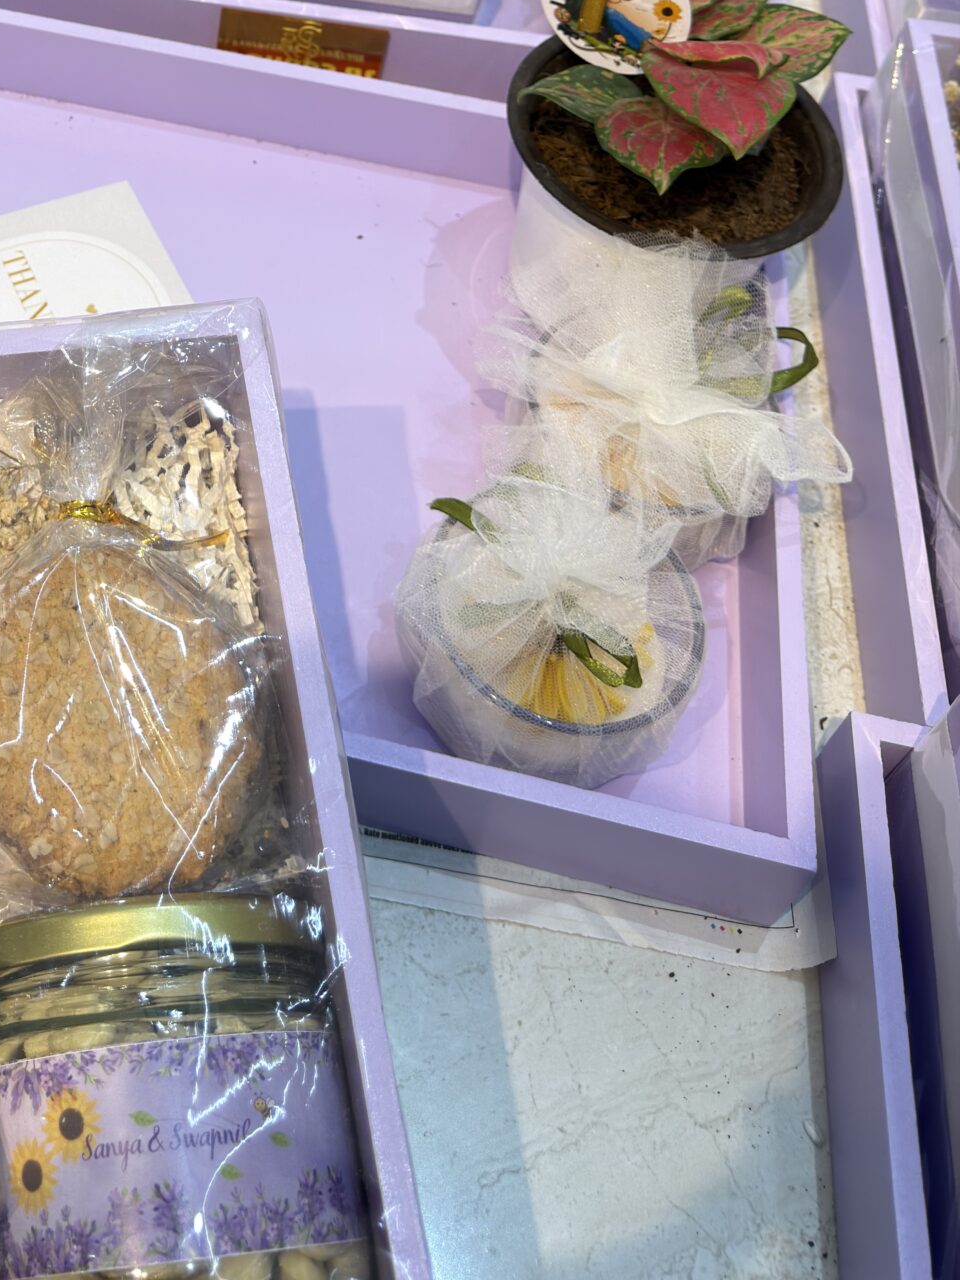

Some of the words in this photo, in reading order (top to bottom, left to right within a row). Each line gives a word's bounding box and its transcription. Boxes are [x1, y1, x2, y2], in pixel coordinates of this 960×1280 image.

[82, 1132, 142, 1173] Sanya
[147, 1124, 165, 1153] &
[169, 1118, 253, 1160] Swapnil
